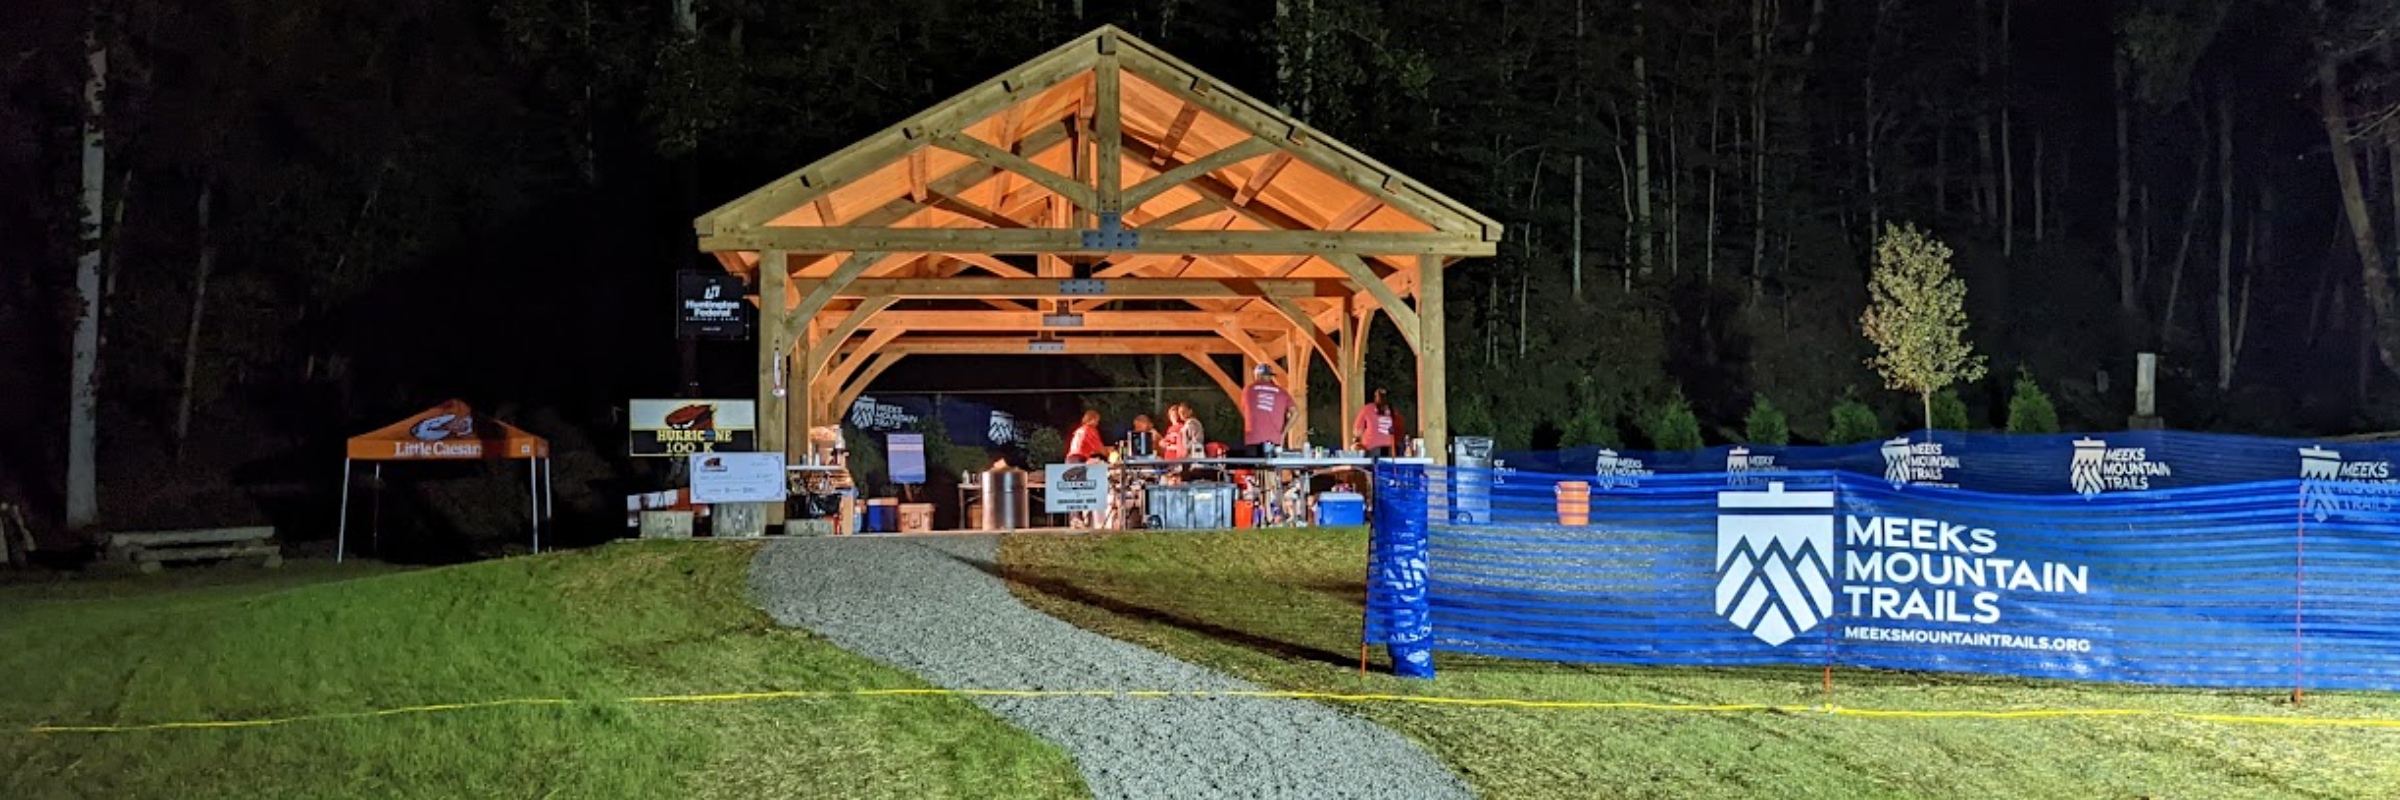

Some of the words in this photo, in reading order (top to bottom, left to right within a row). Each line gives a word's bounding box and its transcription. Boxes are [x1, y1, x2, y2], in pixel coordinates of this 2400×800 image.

[685, 299, 740, 309] Huntington
[693, 308, 731, 317] Federal
[656, 429, 732, 442] HURRICNE
[394, 441, 431, 456] Little
[433, 441, 481, 456] Caesar
[666, 442, 696, 453] 100
[703, 442, 715, 454] K
[2105, 447, 2146, 461] MEEKS
[2103, 461, 2171, 477] MOUNTAIN
[2339, 461, 2390, 478] MEEKS
[2103, 476, 2149, 490] TRAILS
[1845, 550, 2089, 595] MOUNTAIN
[1843, 586, 2001, 624] TRAILS
[1844, 626, 2091, 653] MEEKSMOUNTAINTRAILS.ORG
